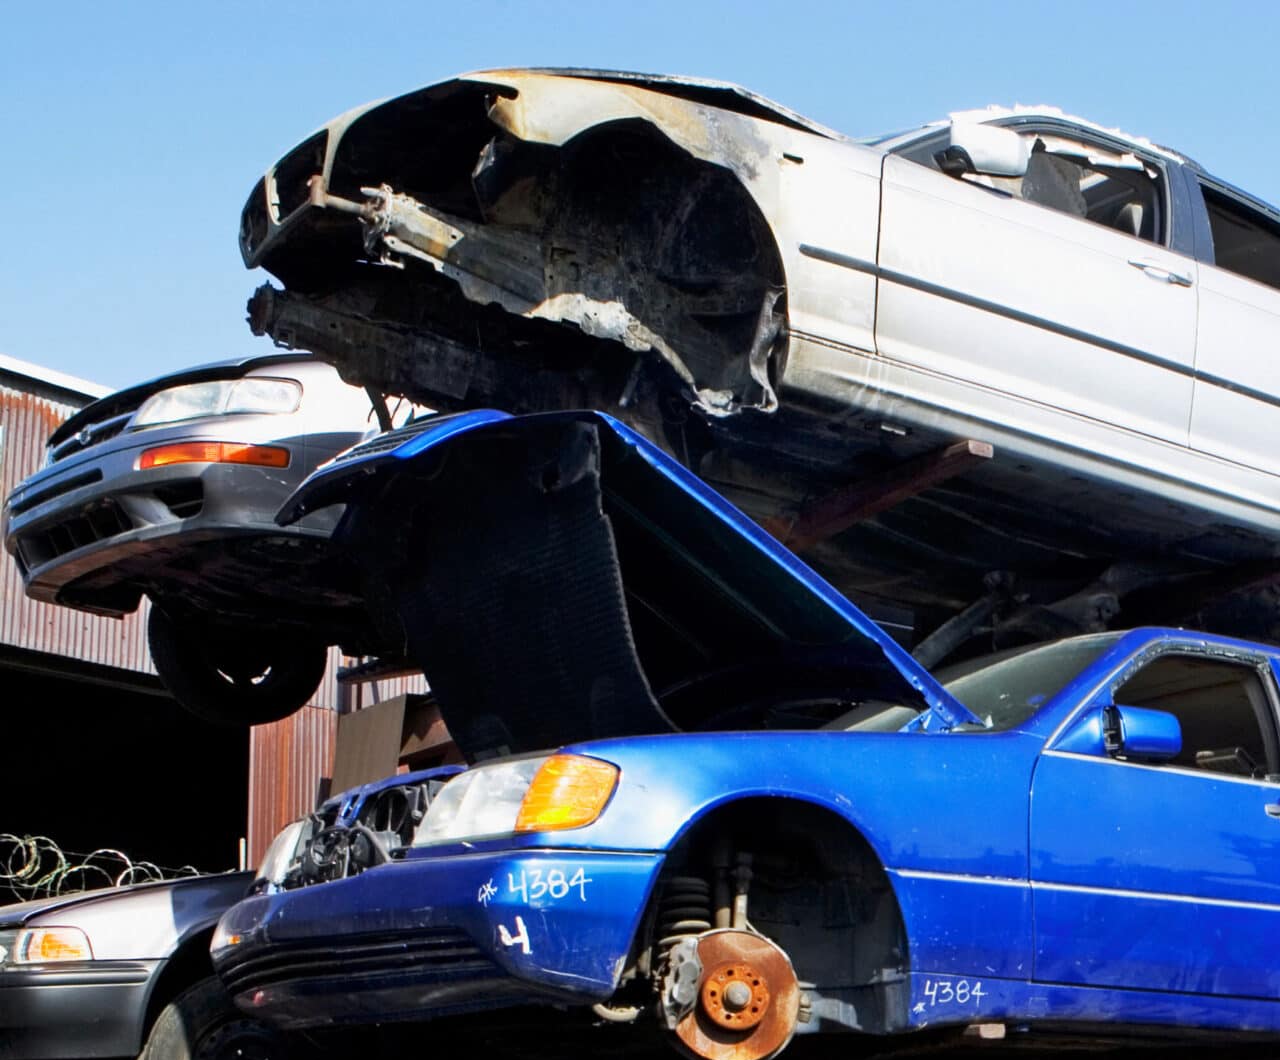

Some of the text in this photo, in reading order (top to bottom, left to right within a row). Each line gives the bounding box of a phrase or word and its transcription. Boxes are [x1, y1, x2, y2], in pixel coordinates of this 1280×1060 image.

[508, 867, 593, 904] 4384
[498, 915, 534, 955] 4
[924, 980, 989, 1007] 4384
